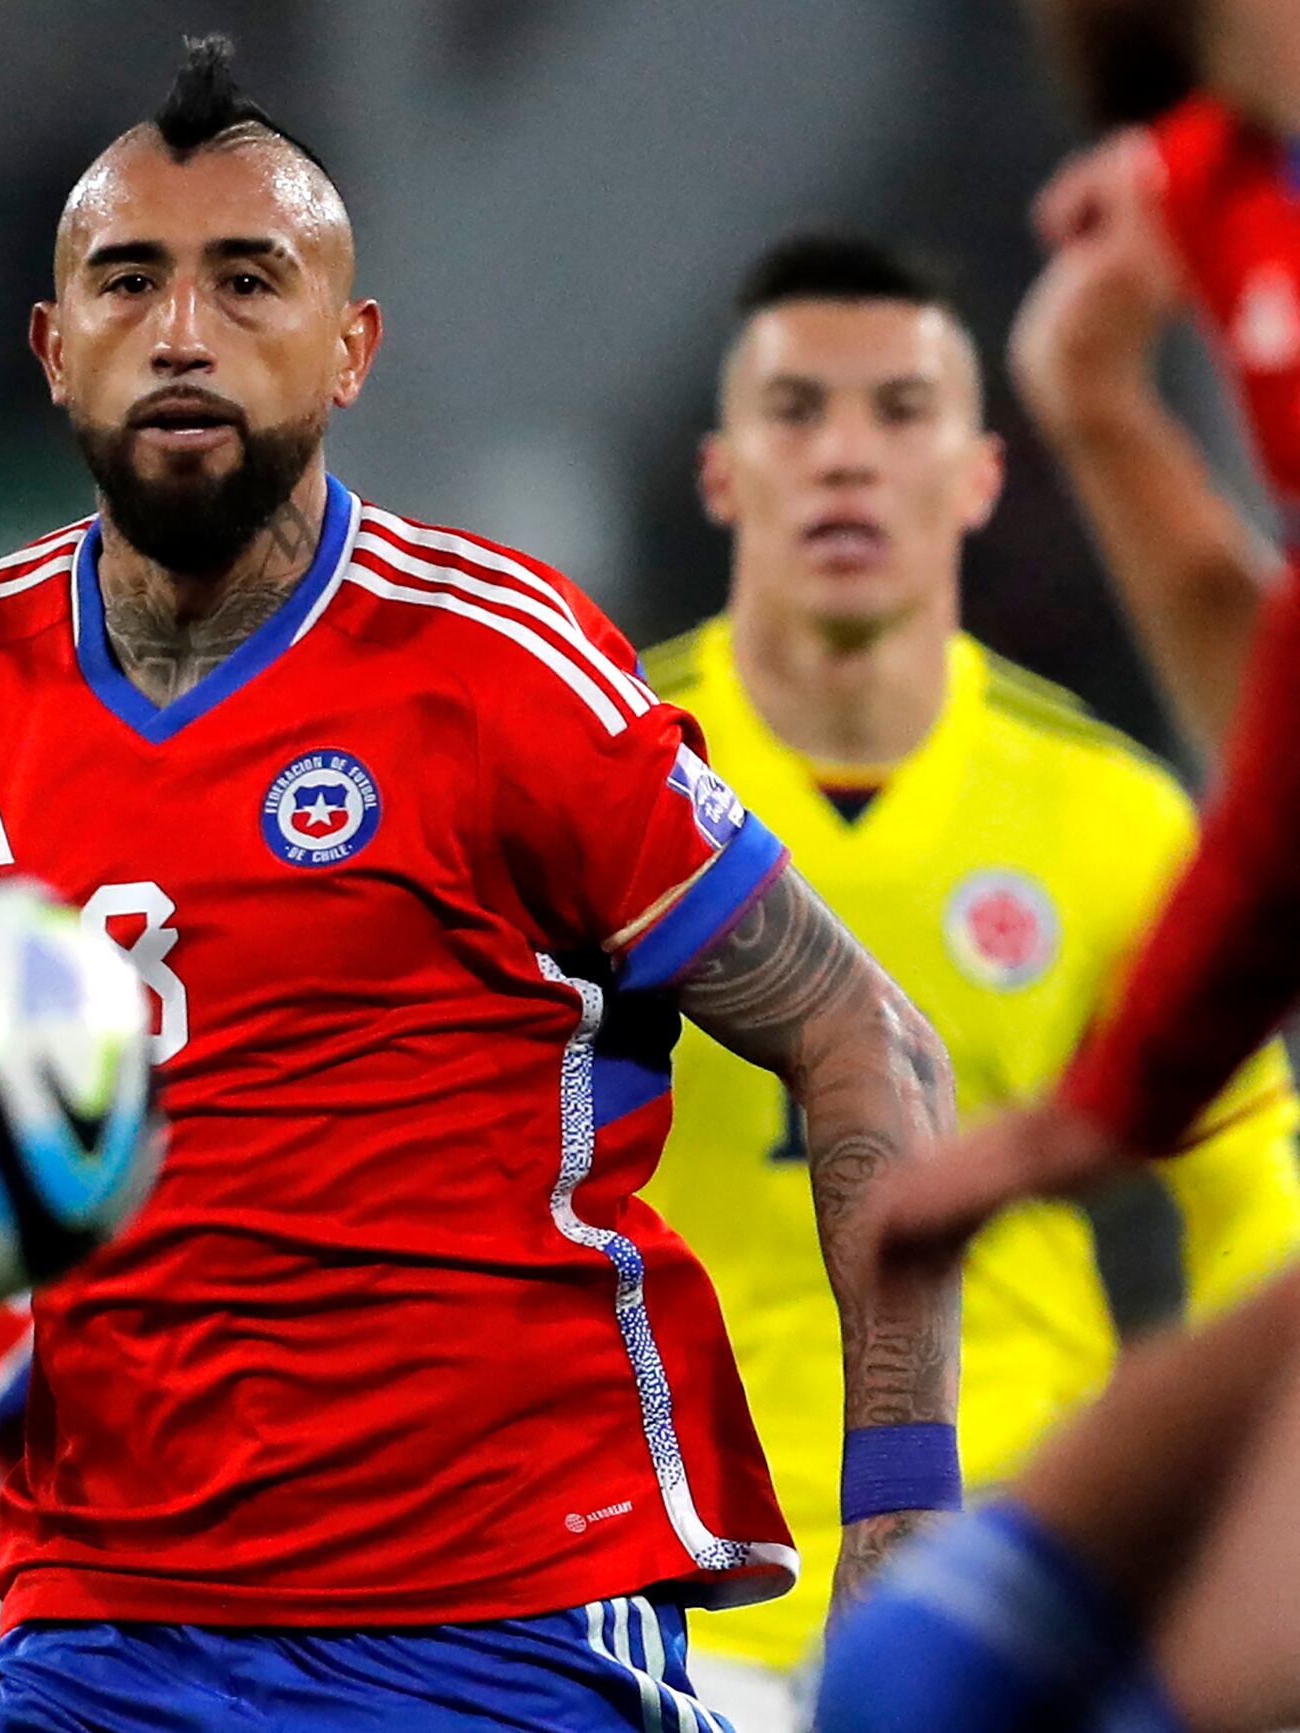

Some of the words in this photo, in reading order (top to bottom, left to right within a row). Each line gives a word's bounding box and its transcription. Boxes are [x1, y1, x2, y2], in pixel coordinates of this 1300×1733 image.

[330, 756, 347, 770] DE
[288, 848, 306, 861] DE
[311, 845, 350, 862] CHILE
[80, 881, 188, 1066] 8
